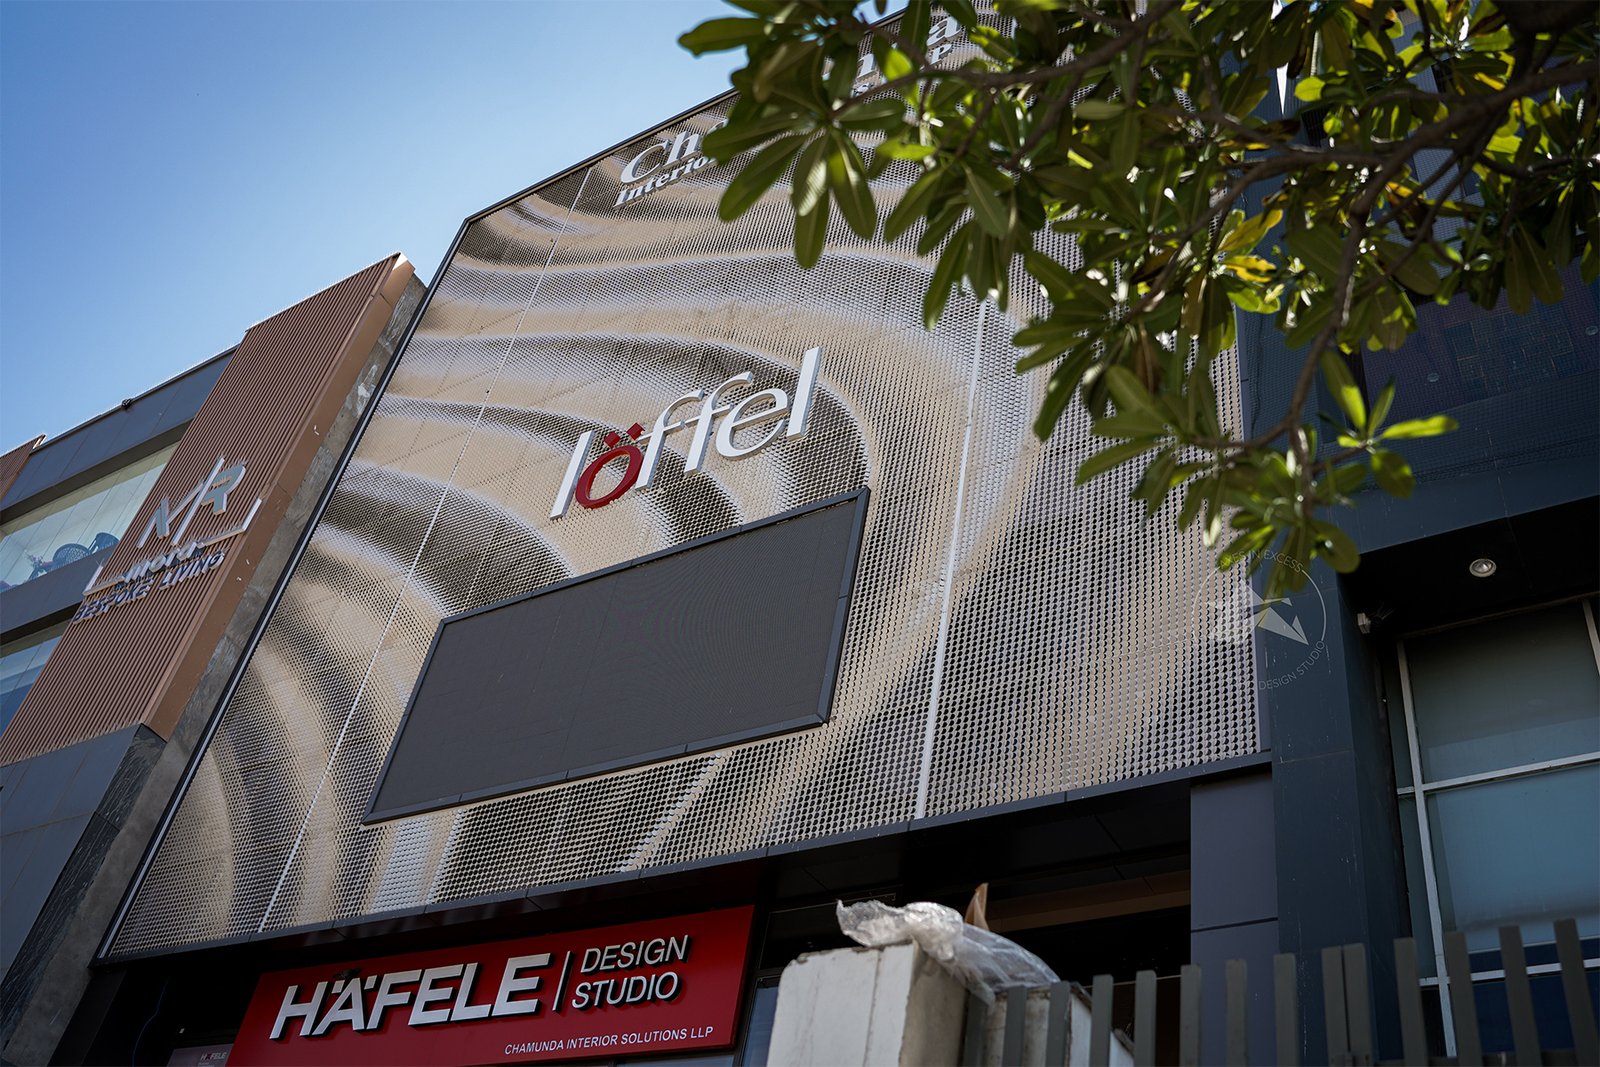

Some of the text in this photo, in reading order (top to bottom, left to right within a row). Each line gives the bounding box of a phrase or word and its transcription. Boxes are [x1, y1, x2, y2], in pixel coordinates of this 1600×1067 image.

[612, 156, 719, 208] Interio
[550, 346, 821, 519] löffel
[73, 550, 226, 624] BESPOKE LIVING
[579, 935, 690, 974] DESIGN
[269, 952, 552, 1041] HÄFELE
[571, 971, 681, 1009] STUDIO
[504, 1026, 714, 1055] CHAMUNDA INTERIOR SOLUTIONS LLP
